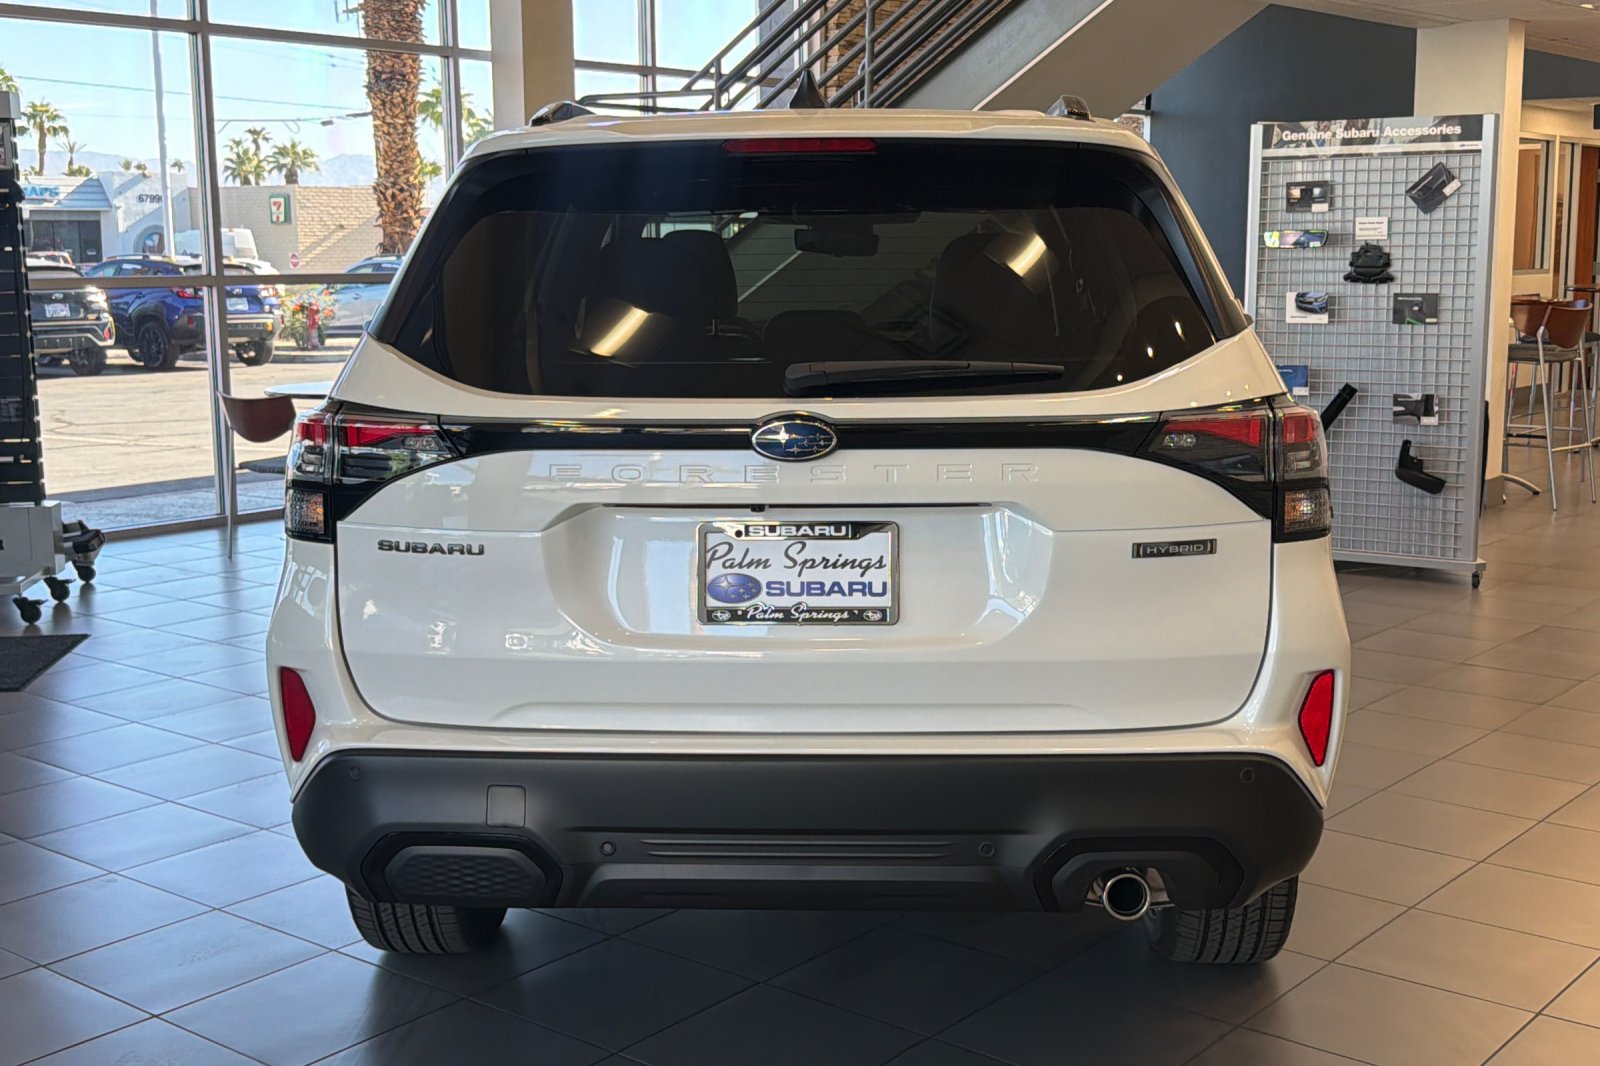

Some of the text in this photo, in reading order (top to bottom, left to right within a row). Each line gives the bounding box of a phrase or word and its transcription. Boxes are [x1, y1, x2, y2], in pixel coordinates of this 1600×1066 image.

[1282, 124, 1462, 141] Genuine Subaru Accessories
[549, 464, 1040, 483] FORESTER
[748, 525, 846, 537] SUBARU
[377, 539, 485, 556] SUBARU
[1146, 543, 1204, 554] HYBRID
[707, 541, 887, 577] Palm Springs
[765, 581, 887, 597] SUBARU
[747, 603, 850, 623] Palm Springs
